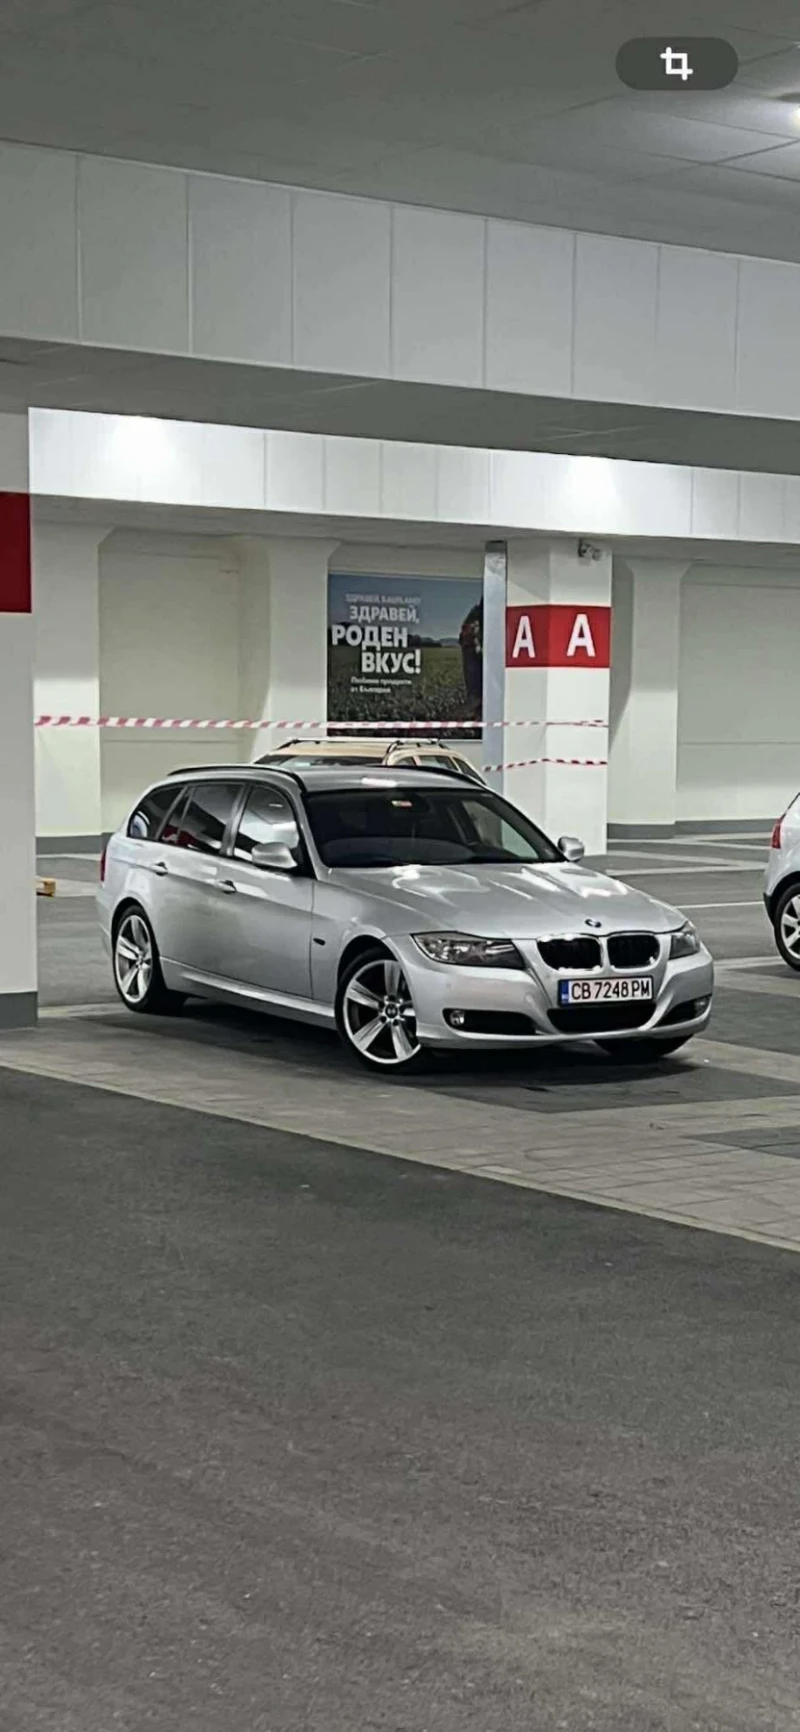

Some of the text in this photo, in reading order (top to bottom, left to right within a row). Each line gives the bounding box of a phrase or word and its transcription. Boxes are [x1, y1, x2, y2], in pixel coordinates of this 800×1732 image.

[349, 604, 420, 624] ЗДРАВЕЙ,
[331, 624, 408, 652] РОДЕН
[361, 648, 421, 674] ВКУС!
[571, 982, 591, 1000] CB
[594, 981, 629, 999] 7248
